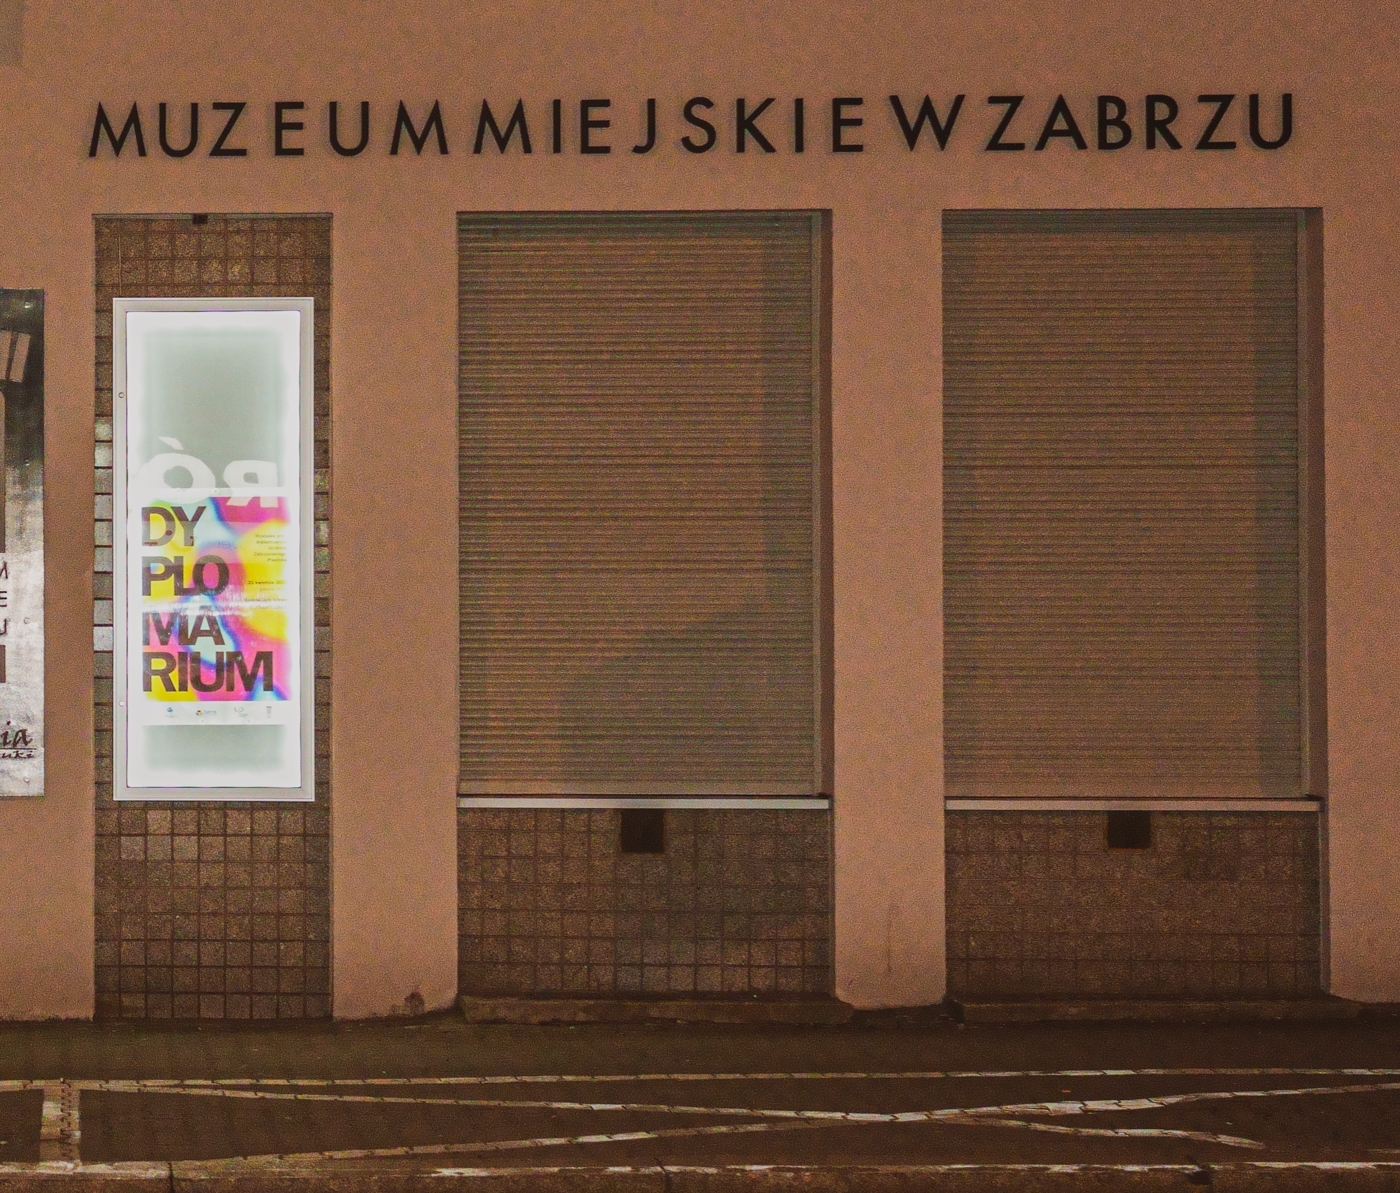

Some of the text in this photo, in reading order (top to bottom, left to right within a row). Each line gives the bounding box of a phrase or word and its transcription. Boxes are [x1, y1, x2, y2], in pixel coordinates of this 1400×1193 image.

[88, 92, 1294, 158] MUZEUM MIEJSKIE W ZABRZU
[141, 506, 206, 546] DY
[141, 554, 230, 597] PLO
[141, 605, 226, 646] MA
[142, 650, 274, 693] RIUM
